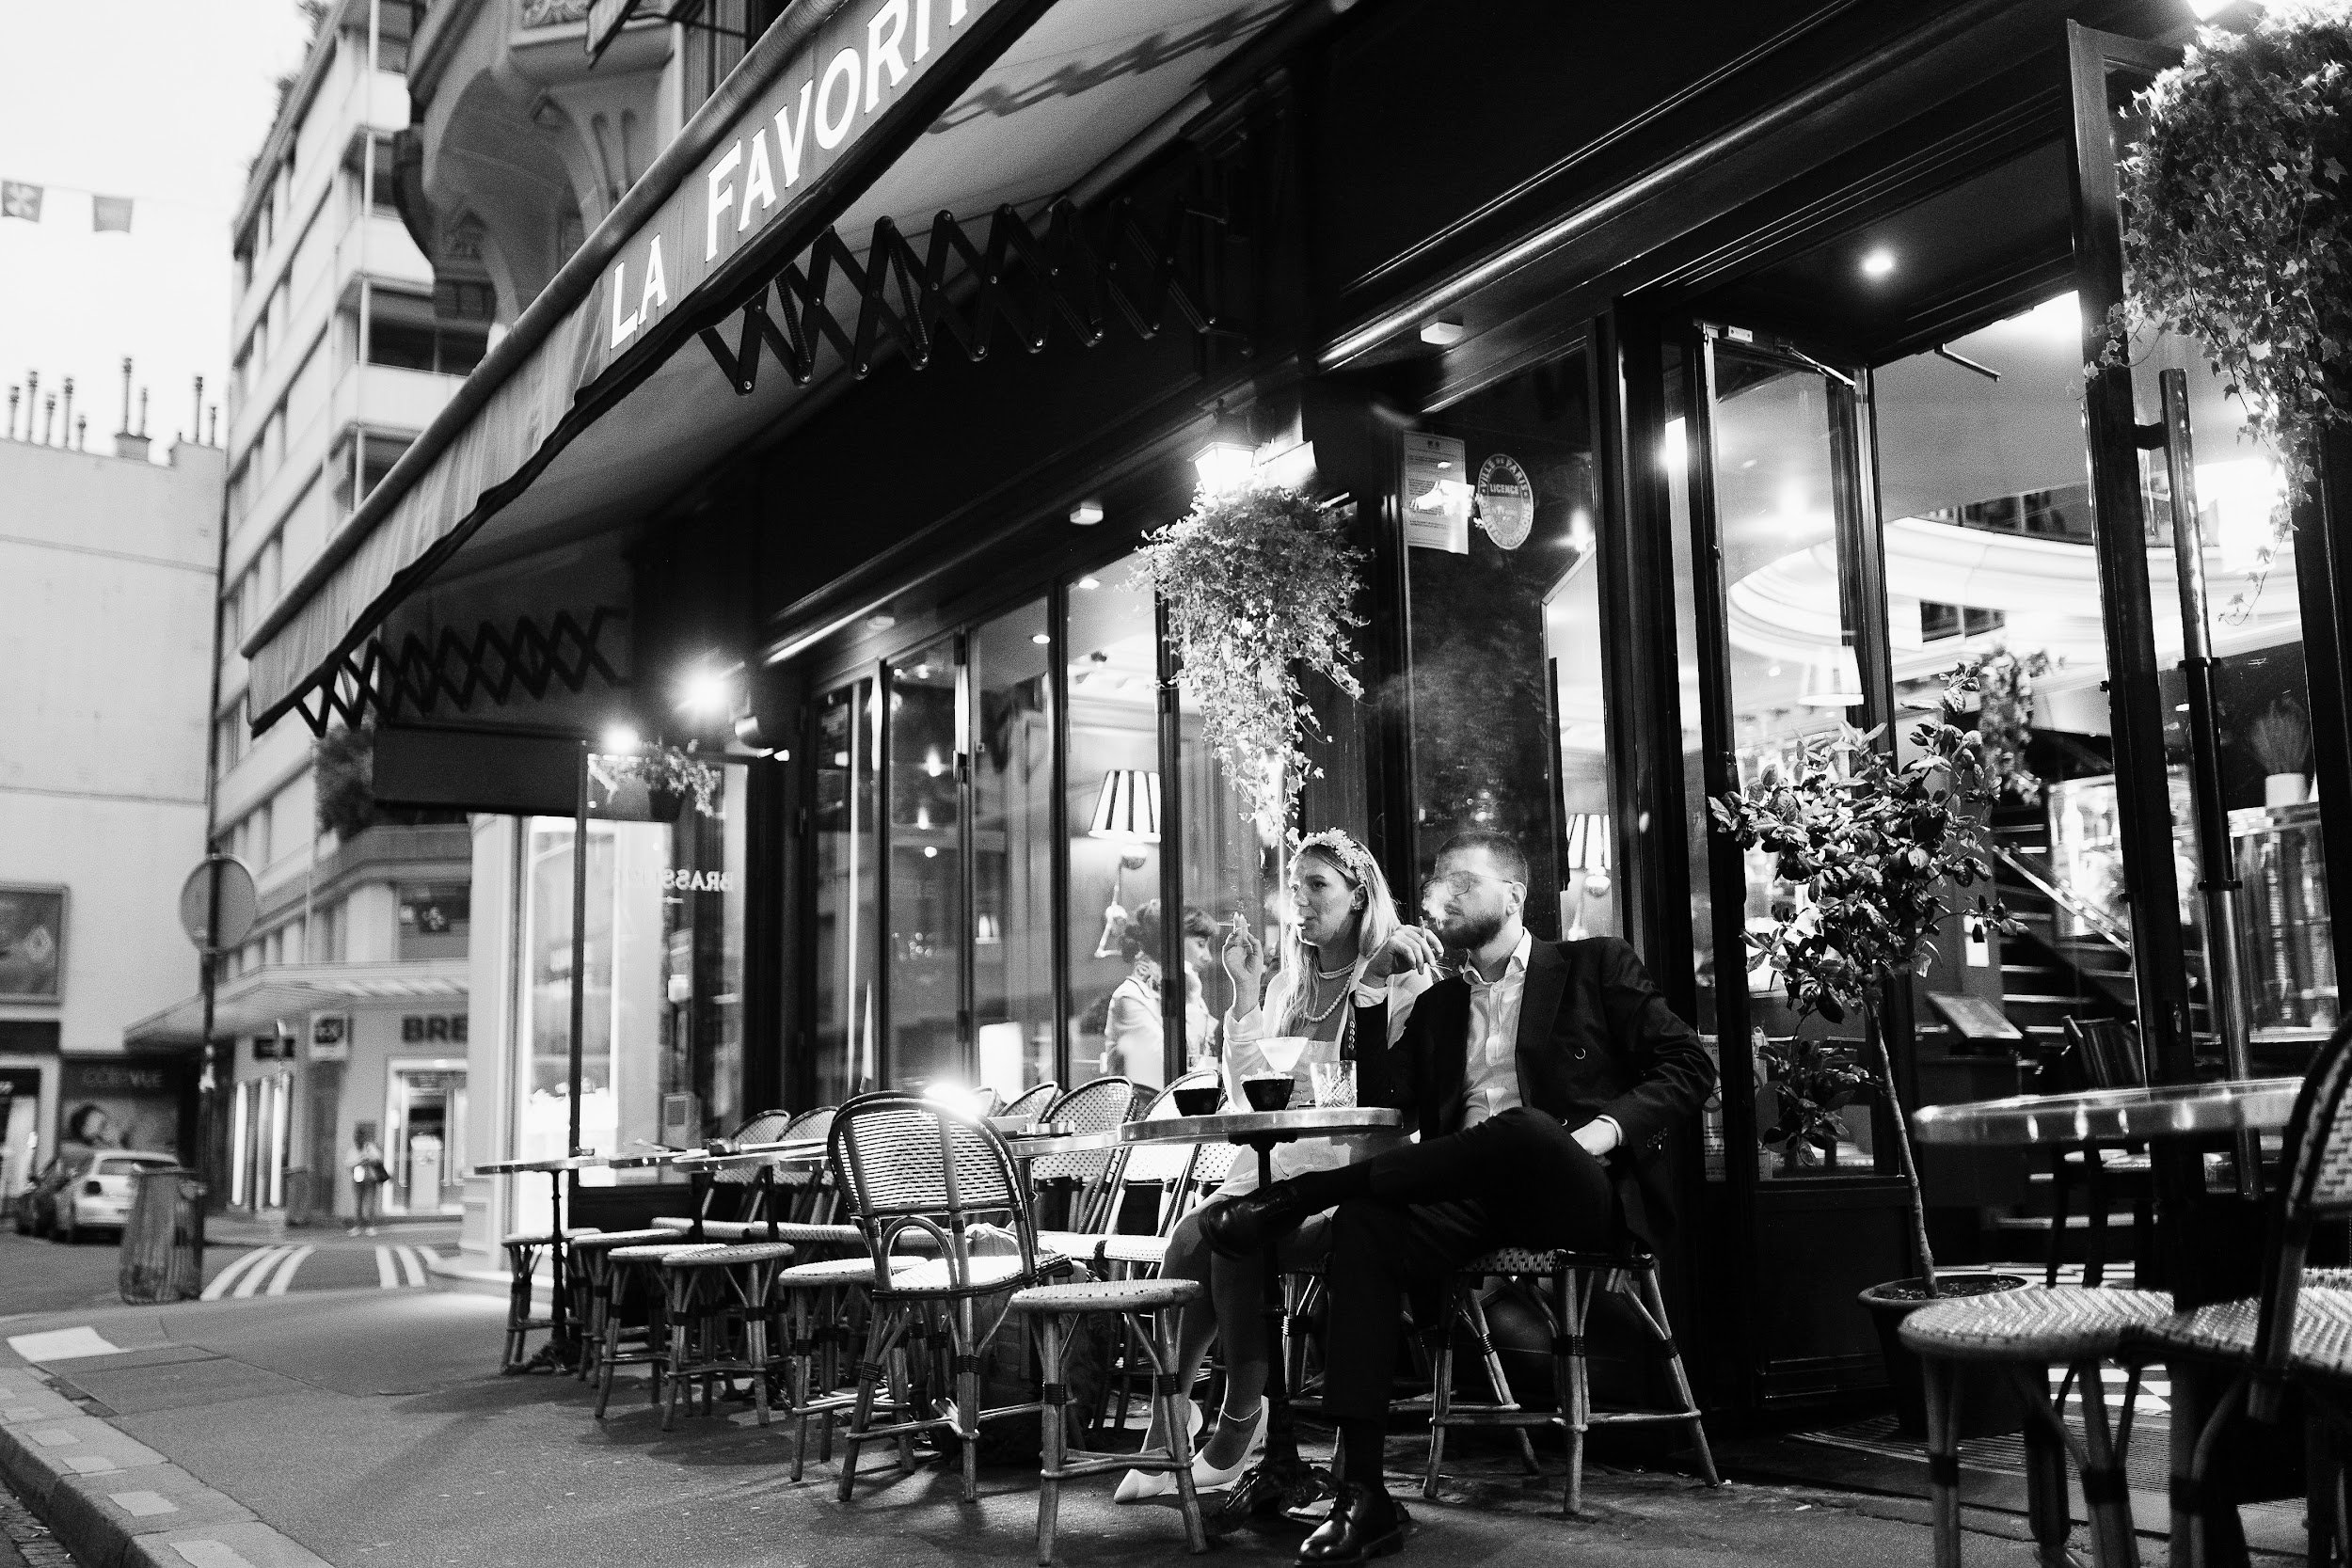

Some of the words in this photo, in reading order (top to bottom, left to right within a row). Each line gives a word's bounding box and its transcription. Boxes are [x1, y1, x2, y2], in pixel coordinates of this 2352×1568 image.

[610, 234, 667, 349] LA
[705, 0, 967, 262] FAVORI
[1480, 460, 1495, 487] VILLE
[1505, 459, 1528, 490] PARIS
[1489, 483, 1518, 495] LICENCE
[404, 1016, 469, 1042] BRE
